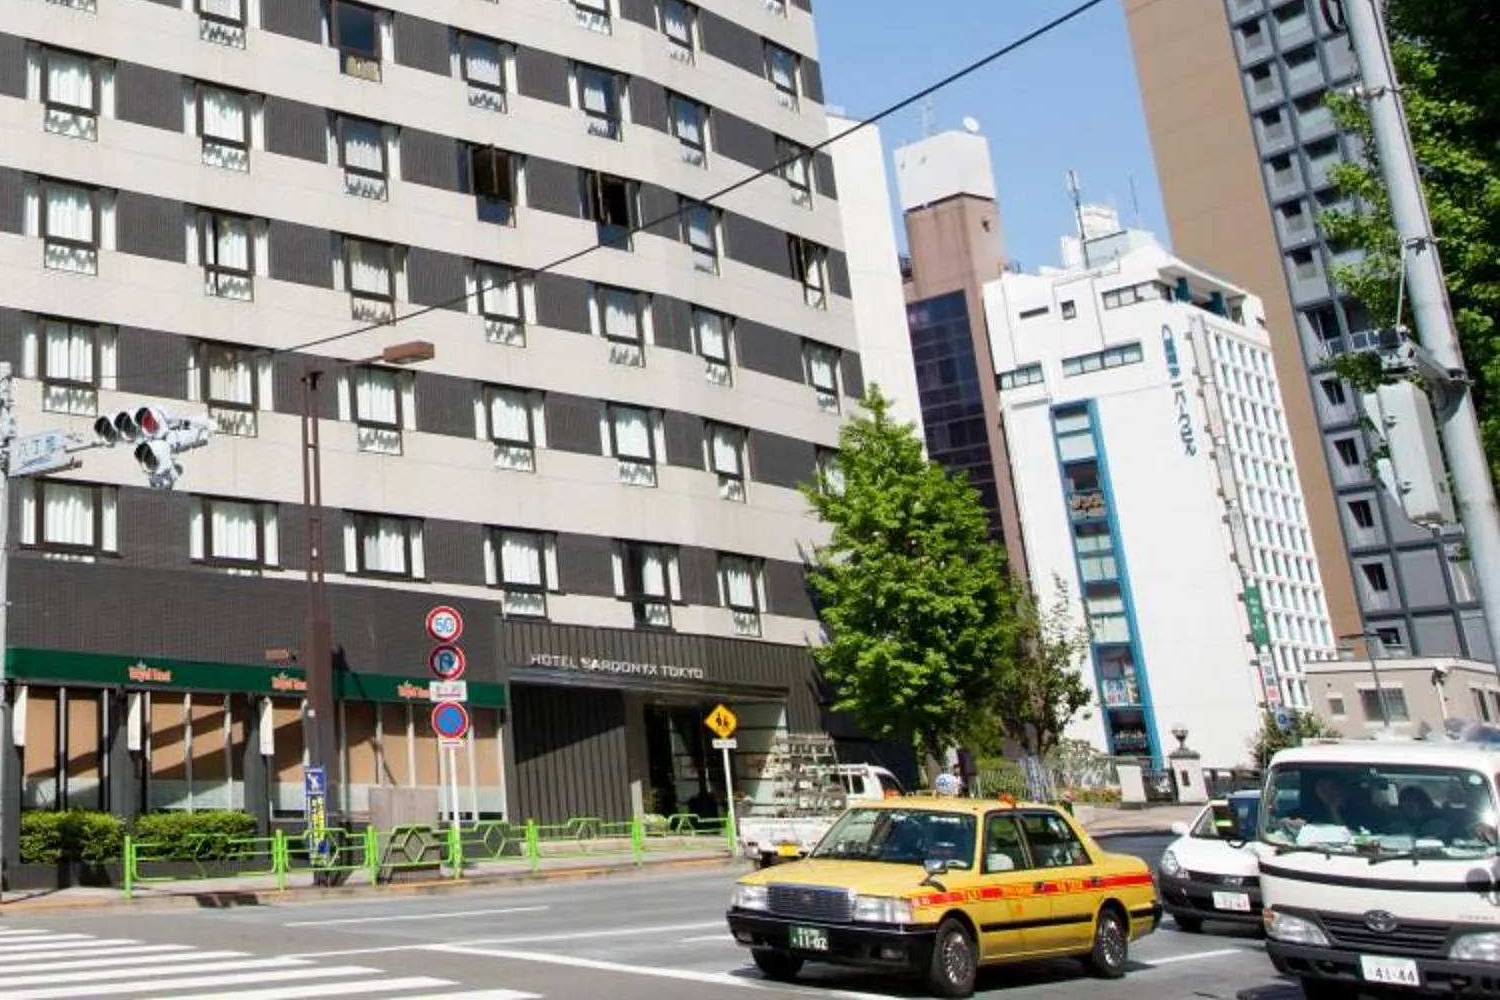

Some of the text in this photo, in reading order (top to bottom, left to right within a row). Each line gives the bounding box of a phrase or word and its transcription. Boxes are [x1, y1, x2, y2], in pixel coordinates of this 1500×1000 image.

[530, 653, 704, 679] HOTEL SARDONYX TOKYO
